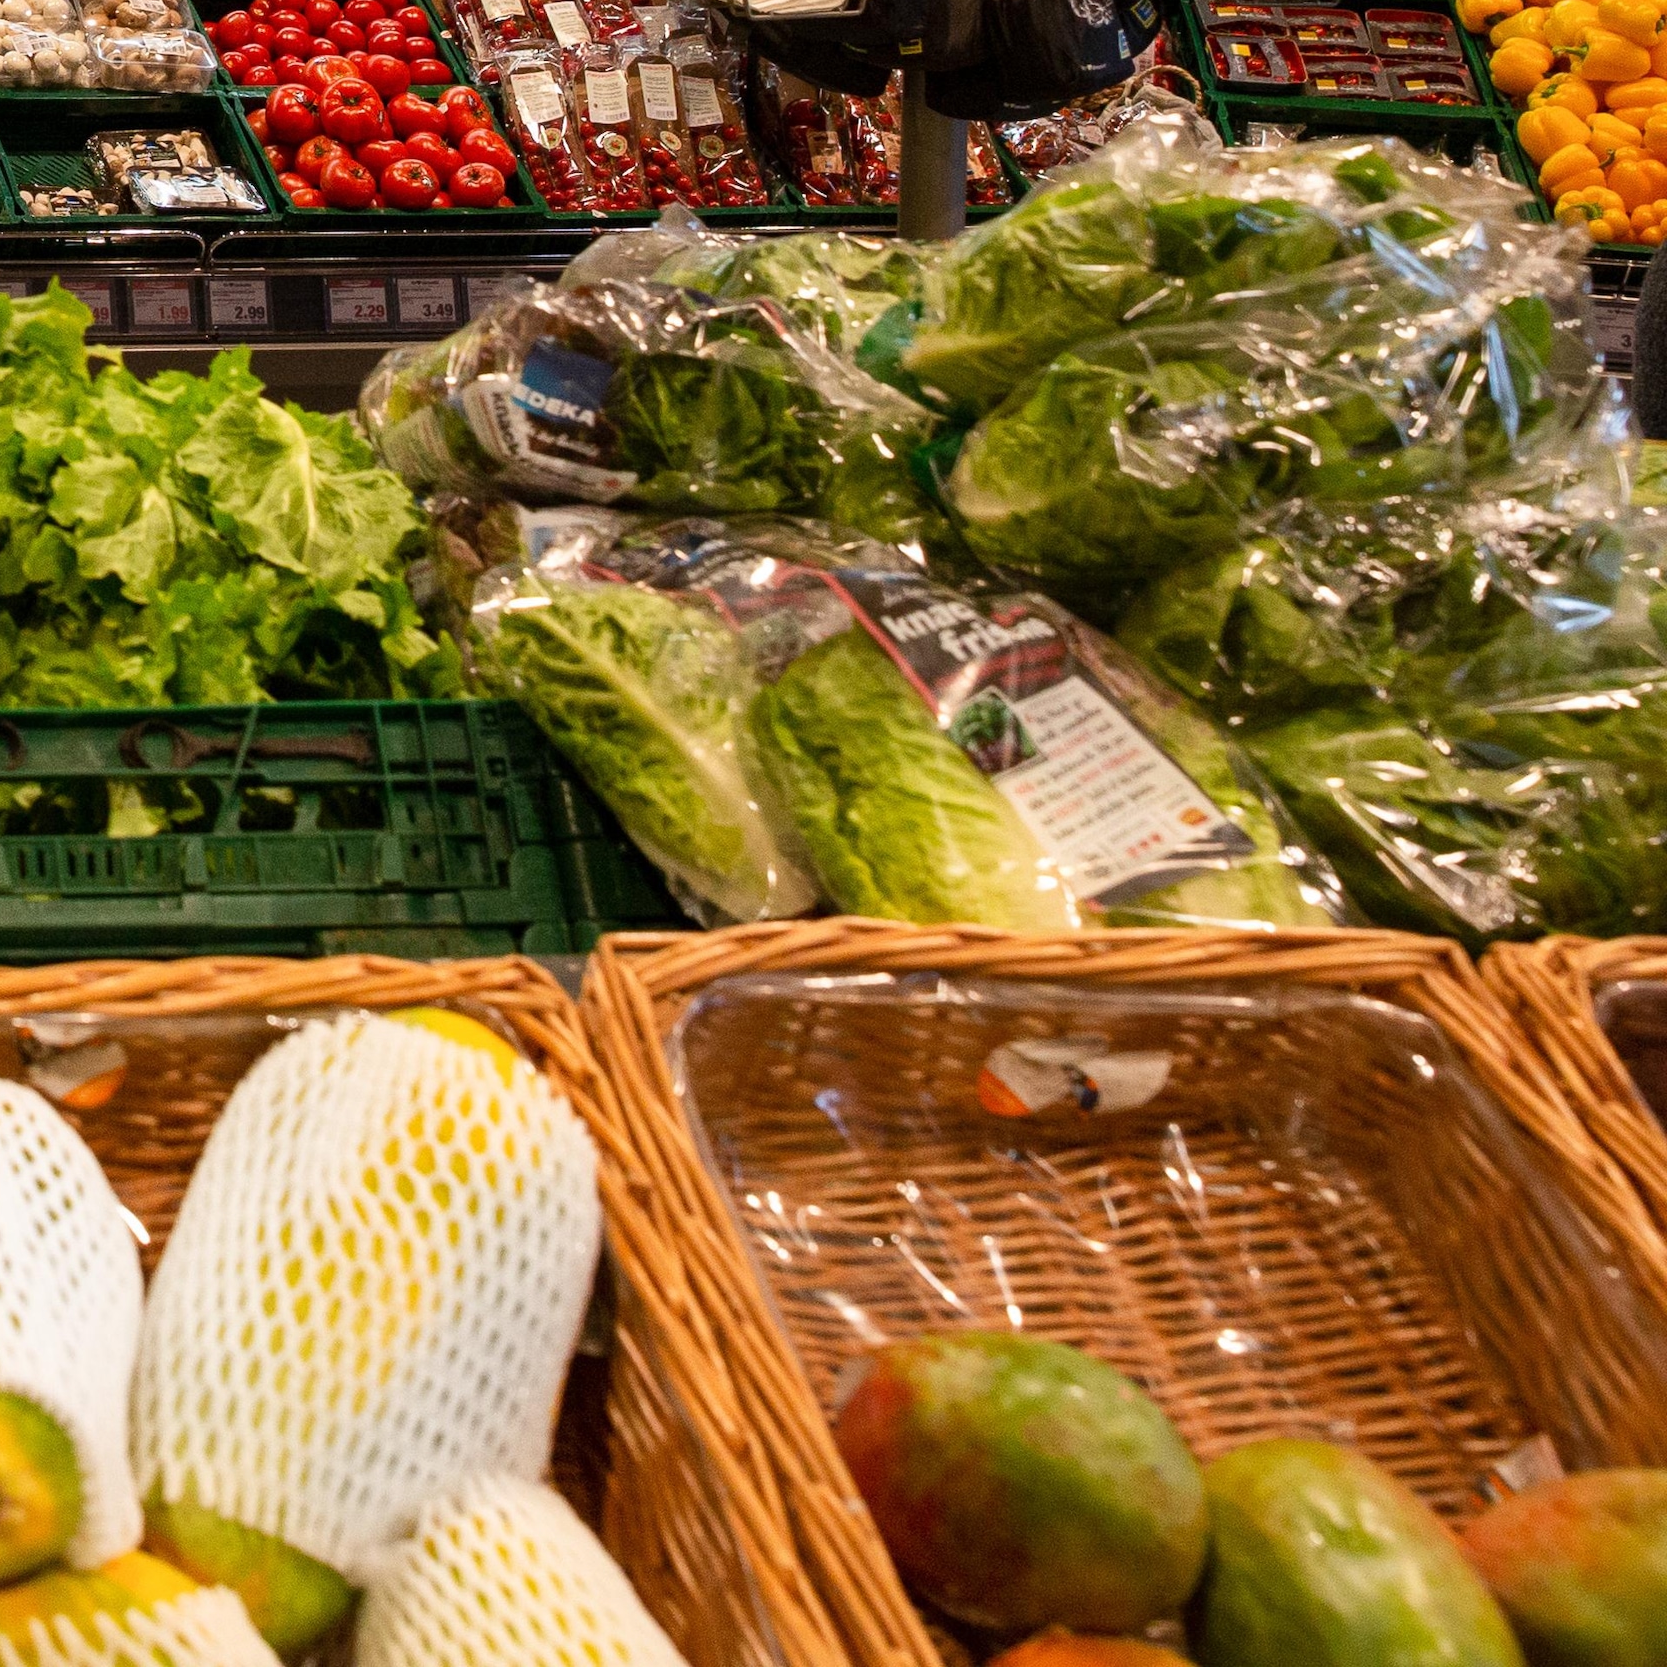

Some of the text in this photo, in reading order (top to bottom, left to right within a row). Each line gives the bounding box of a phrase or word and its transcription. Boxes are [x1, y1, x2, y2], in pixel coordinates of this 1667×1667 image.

[93, 305, 111, 320] 49
[158, 305, 190, 320] 1.99
[234, 305, 266, 320] 2.99
[353, 304, 386, 320] 2.29
[422, 303, 454, 319] 3.49
[512, 382, 597, 428] EDEKA
